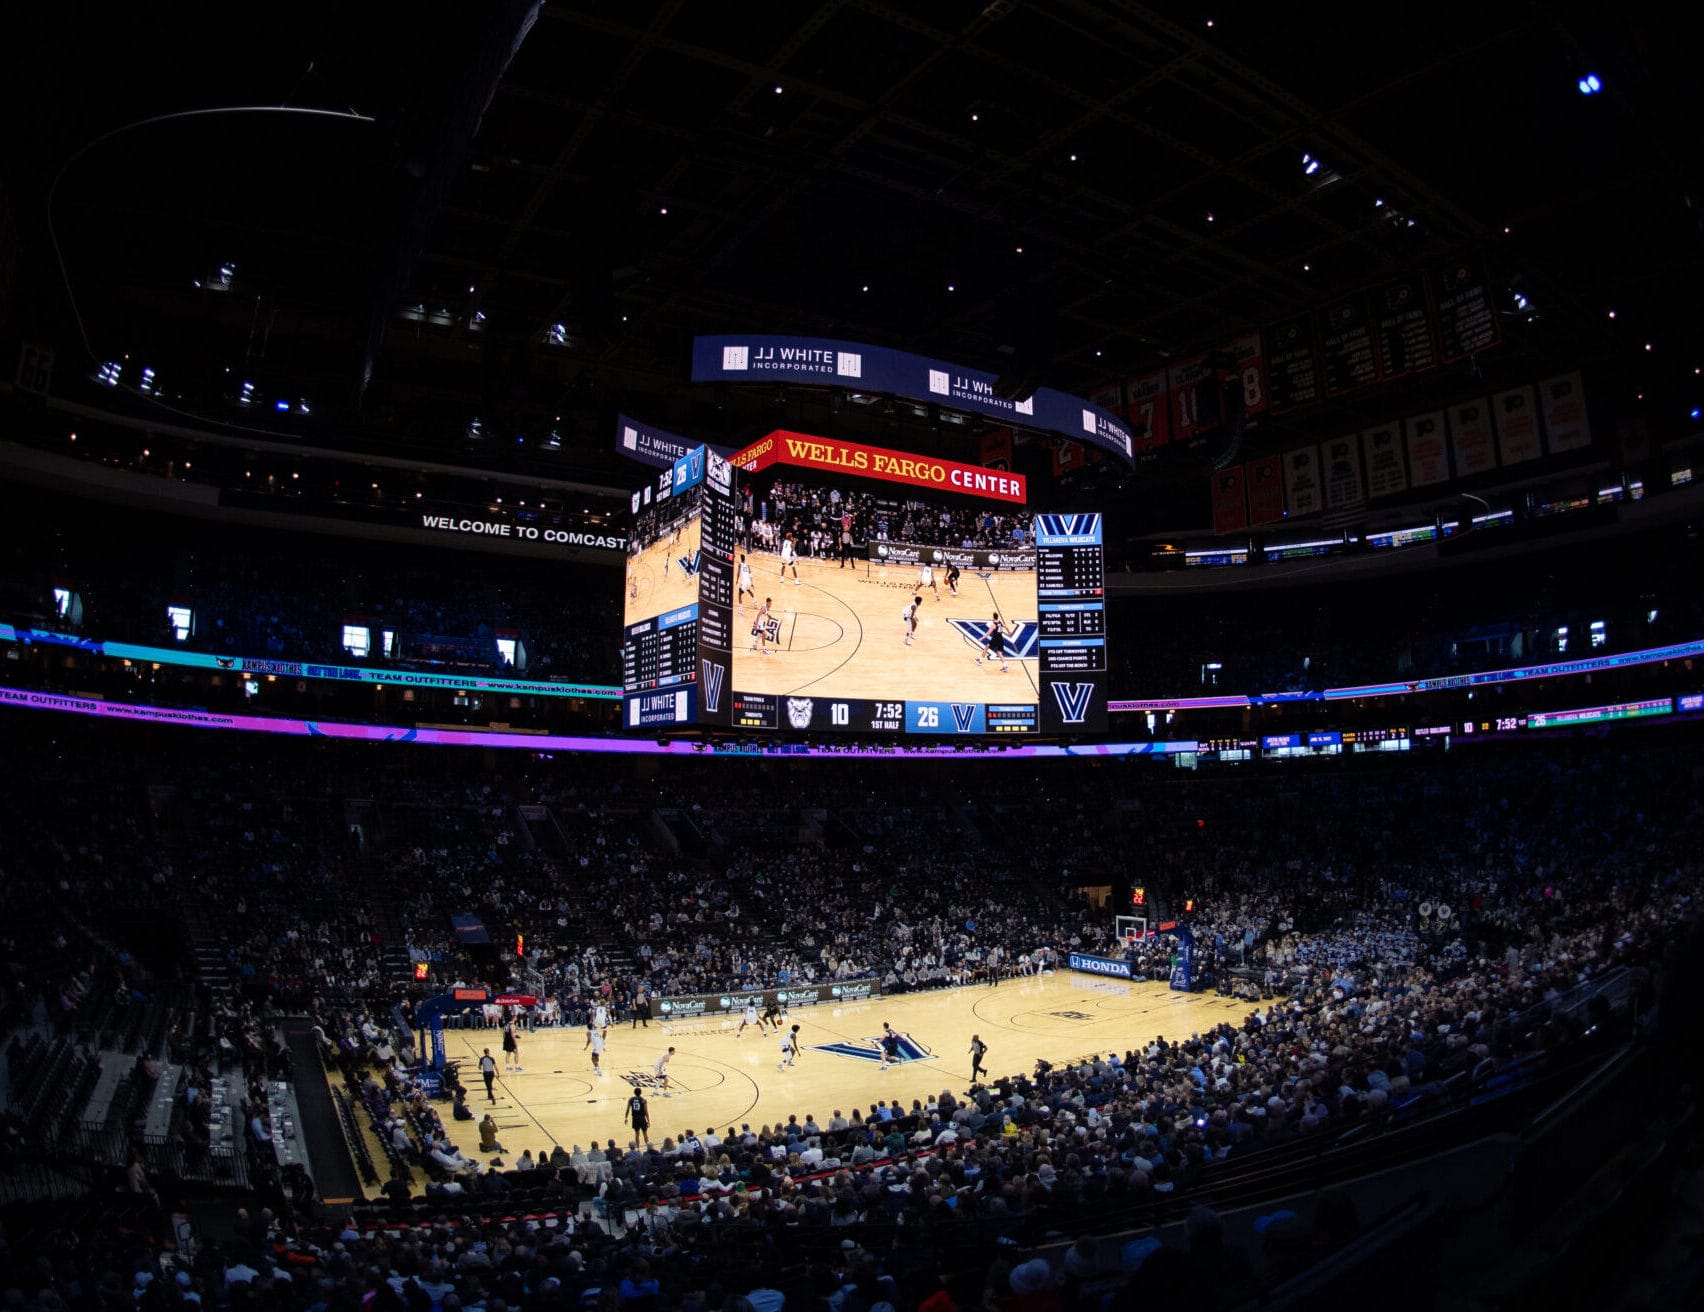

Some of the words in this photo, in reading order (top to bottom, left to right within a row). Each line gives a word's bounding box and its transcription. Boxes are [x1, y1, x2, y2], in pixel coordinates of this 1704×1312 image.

[754, 347, 774, 360] JJ
[780, 347, 833, 364] WHITE
[753, 362, 833, 373] INCORPORATED
[953, 376, 968, 390] JJ
[952, 390, 1013, 409] INCORPORATED
[1108, 421, 1126, 442] WHITE
[639, 434, 650, 447] JJ
[653, 438, 685, 457] WHITE
[747, 439, 773, 462] FARGO
[638, 446, 680, 463] INCORPORAT
[676, 464, 687, 486] 26
[785, 438, 868, 469] WELLS
[873, 454, 946, 483] FARGO
[950, 469, 1021, 497] CENTER
[422, 514, 511, 536] WELCOME
[515, 526, 539, 540] TO
[543, 529, 627, 550] COMCAST
[888, 547, 920, 558] NovaCare
[942, 551, 974, 563] NovaCare
[1000, 554, 1036, 564] NovaCare
[1550, 659, 1610, 675] OUTFITTERS
[370, 672, 402, 682] TEAM
[405, 675, 478, 688] OUTFITTERS
[487, 681, 617, 697] www.kampusklothes.com
[0, 690, 28, 702] TEAM
[31, 695, 97, 711] OUTFITTERS
[107, 705, 233, 725] www.kampusklothes.com
[641, 697, 650, 712] JJ
[651, 693, 675, 710] WHITE
[641, 713, 675, 723] INCORPORATED
[831, 703, 849, 725] 10
[875, 703, 903, 719] 7:52
[917, 707, 939, 728] 26
[1495, 718, 1517, 731] 7:52
[1535, 715, 1546, 727] 26
[871, 720, 883, 729] 1ST
[884, 720, 900, 730] HALF
[1463, 722, 1474, 734] 10
[1081, 959, 1130, 975] HONDA
[787, 989, 819, 1002] NovaCare
[841, 983, 871, 996] NovaCare
[672, 1000, 706, 1012] NovaCare
[632, 1102, 641, 1111] 13
